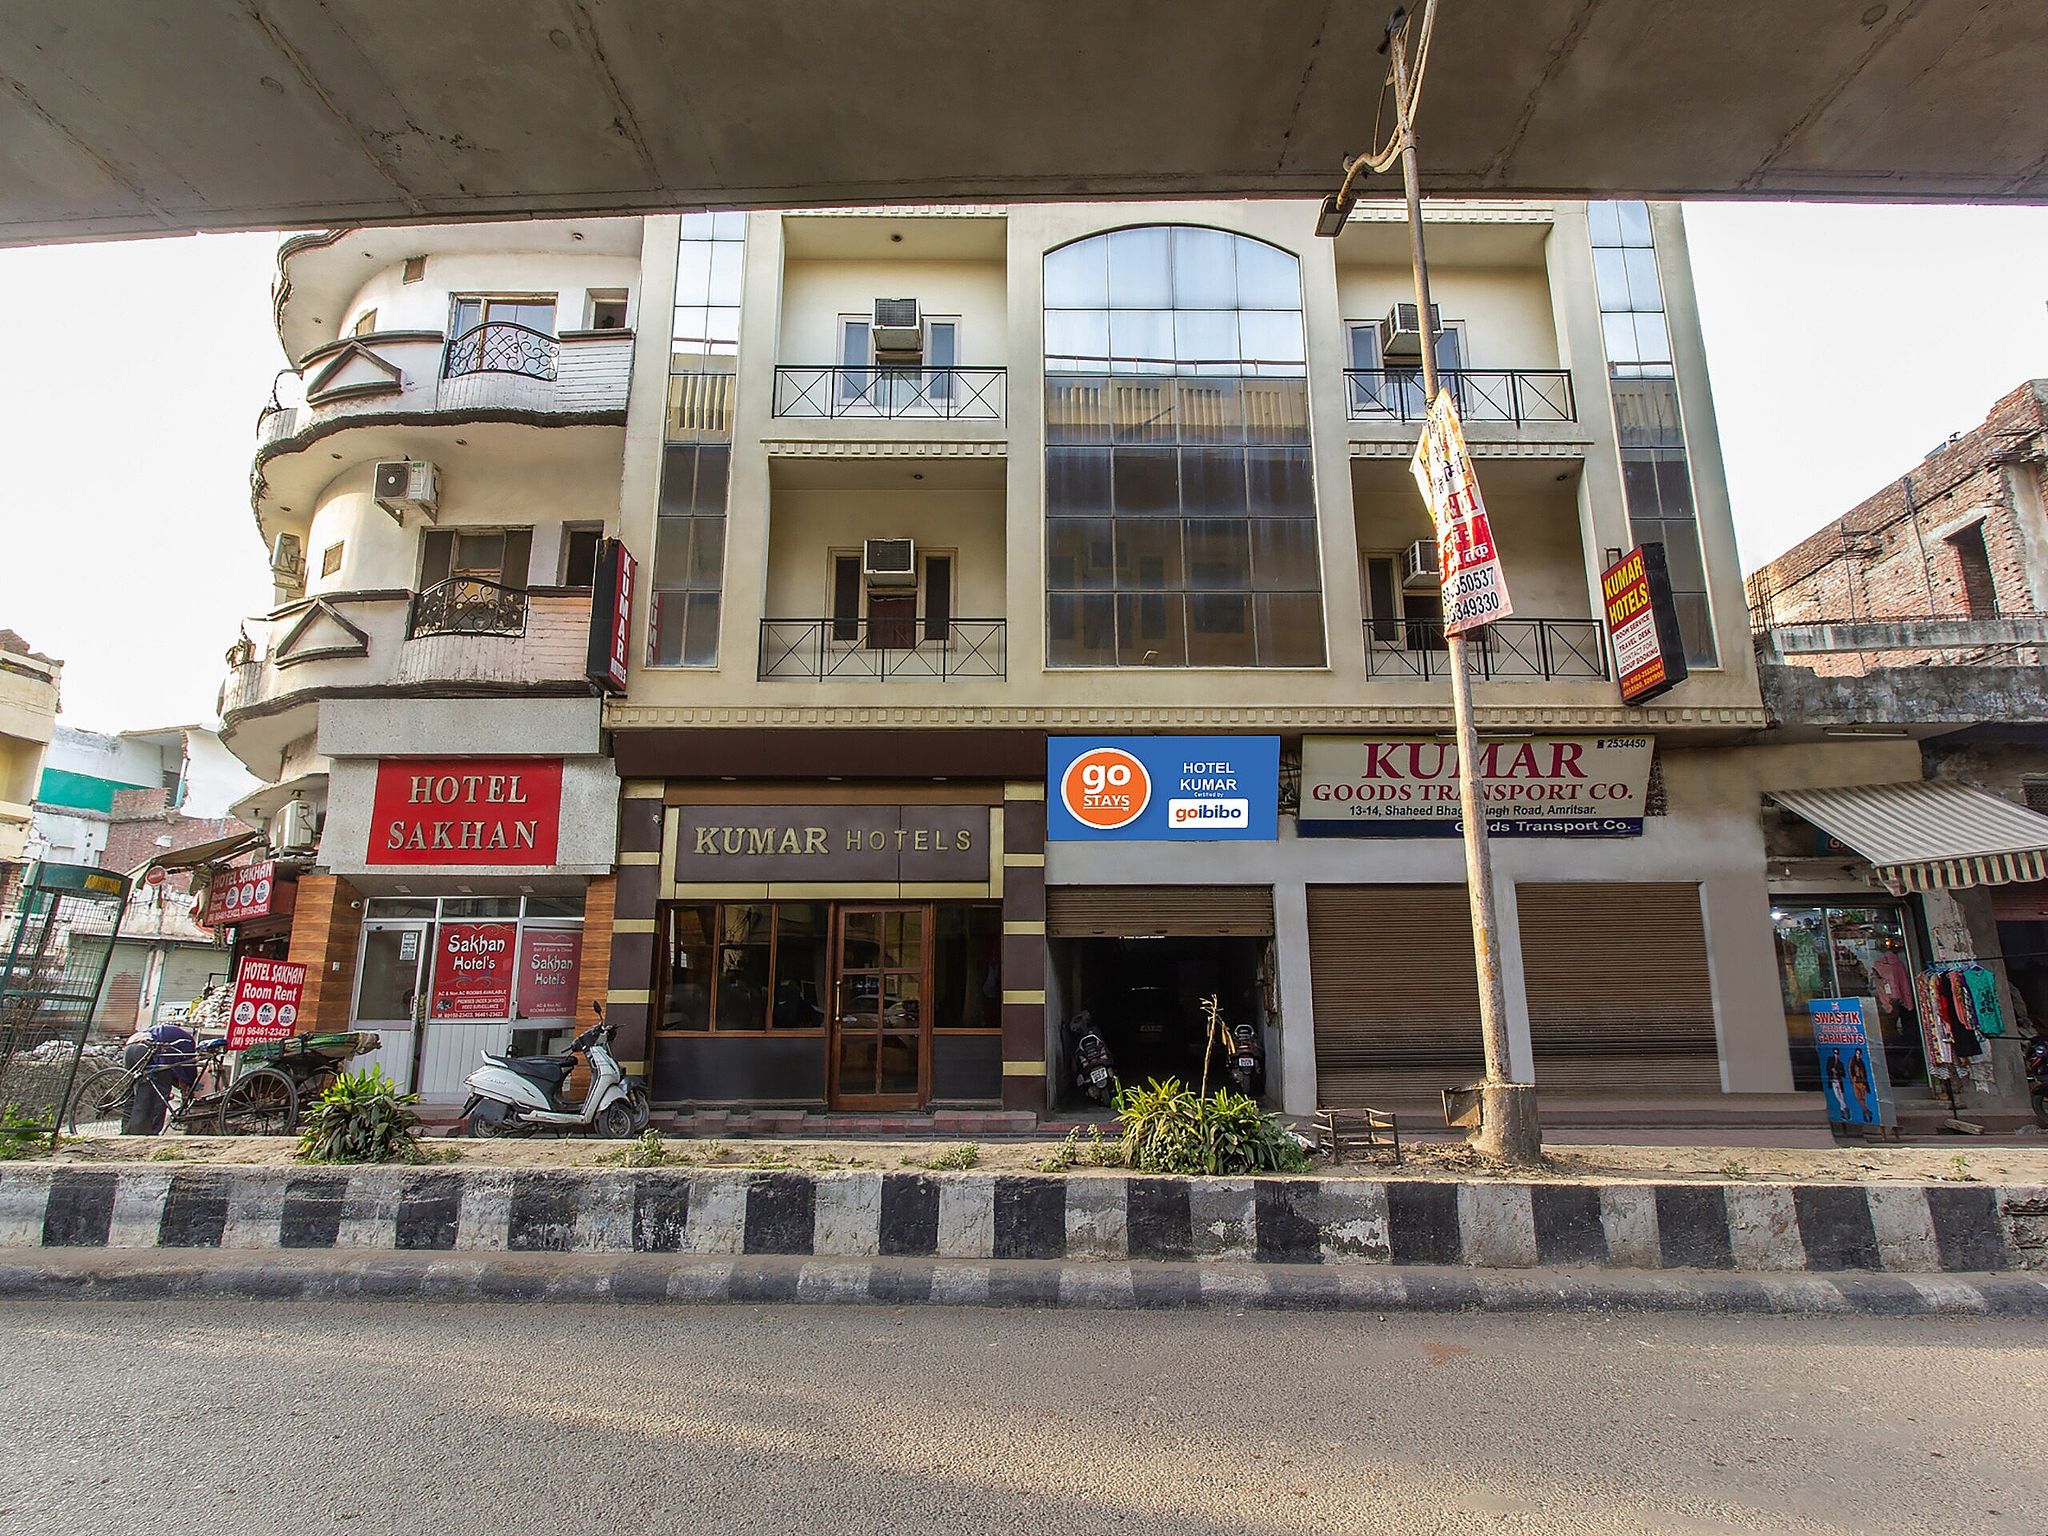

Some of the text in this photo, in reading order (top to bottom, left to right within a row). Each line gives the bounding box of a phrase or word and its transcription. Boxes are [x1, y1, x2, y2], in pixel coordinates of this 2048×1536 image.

[1604, 555, 1643, 600] KUMAR
[616, 552, 631, 663] KUMAR
[1608, 582, 1649, 626] HOTELS
[1616, 614, 1650, 640] ROOM SERVICE
[1618, 629, 1652, 653] TRAVEL DESK
[1620, 646, 1659, 674] GROUP BOOKING
[1621, 640, 1653, 664] CONTACT FOR
[1183, 762, 1235, 774] HOTEL
[1361, 739, 1646, 779] KUMAR 2534450
[408, 775, 528, 803] HOTEL
[1082, 764, 1131, 794] go
[1180, 779, 1237, 790] KUMAR
[1083, 795, 1130, 806] STAYS
[1312, 784, 1412, 801] GOODS
[1589, 782, 1633, 800] CO.
[1176, 805, 1241, 822] goibibo
[1350, 805, 1382, 817] 13-14,
[1385, 805, 1432, 816] Shaheed
[1485, 804, 1510, 818] ingh
[1514, 805, 1544, 816] Road,
[1547, 804, 1597, 815] Amritsar.
[387, 820, 538, 850] SAKHAN
[1454, 820, 1631, 833] Gds Transport Co.
[694, 827, 972, 855] KUMAR HOTELS
[213, 863, 273, 889] HOTEL SAKHAN
[448, 934, 506, 954] Sakhan
[452, 956, 496, 970] Hotel's
[530, 954, 573, 972] Sakhan
[242, 962, 304, 985] HOTEL SAKHAN
[534, 973, 567, 986] Hotel's
[242, 982, 297, 1002] Room Rent
[1814, 1011, 1861, 1024] SWASTIK
[233, 1026, 290, 1037] (M) 96461-23423
[1817, 1033, 1865, 1045] GARMENTS
